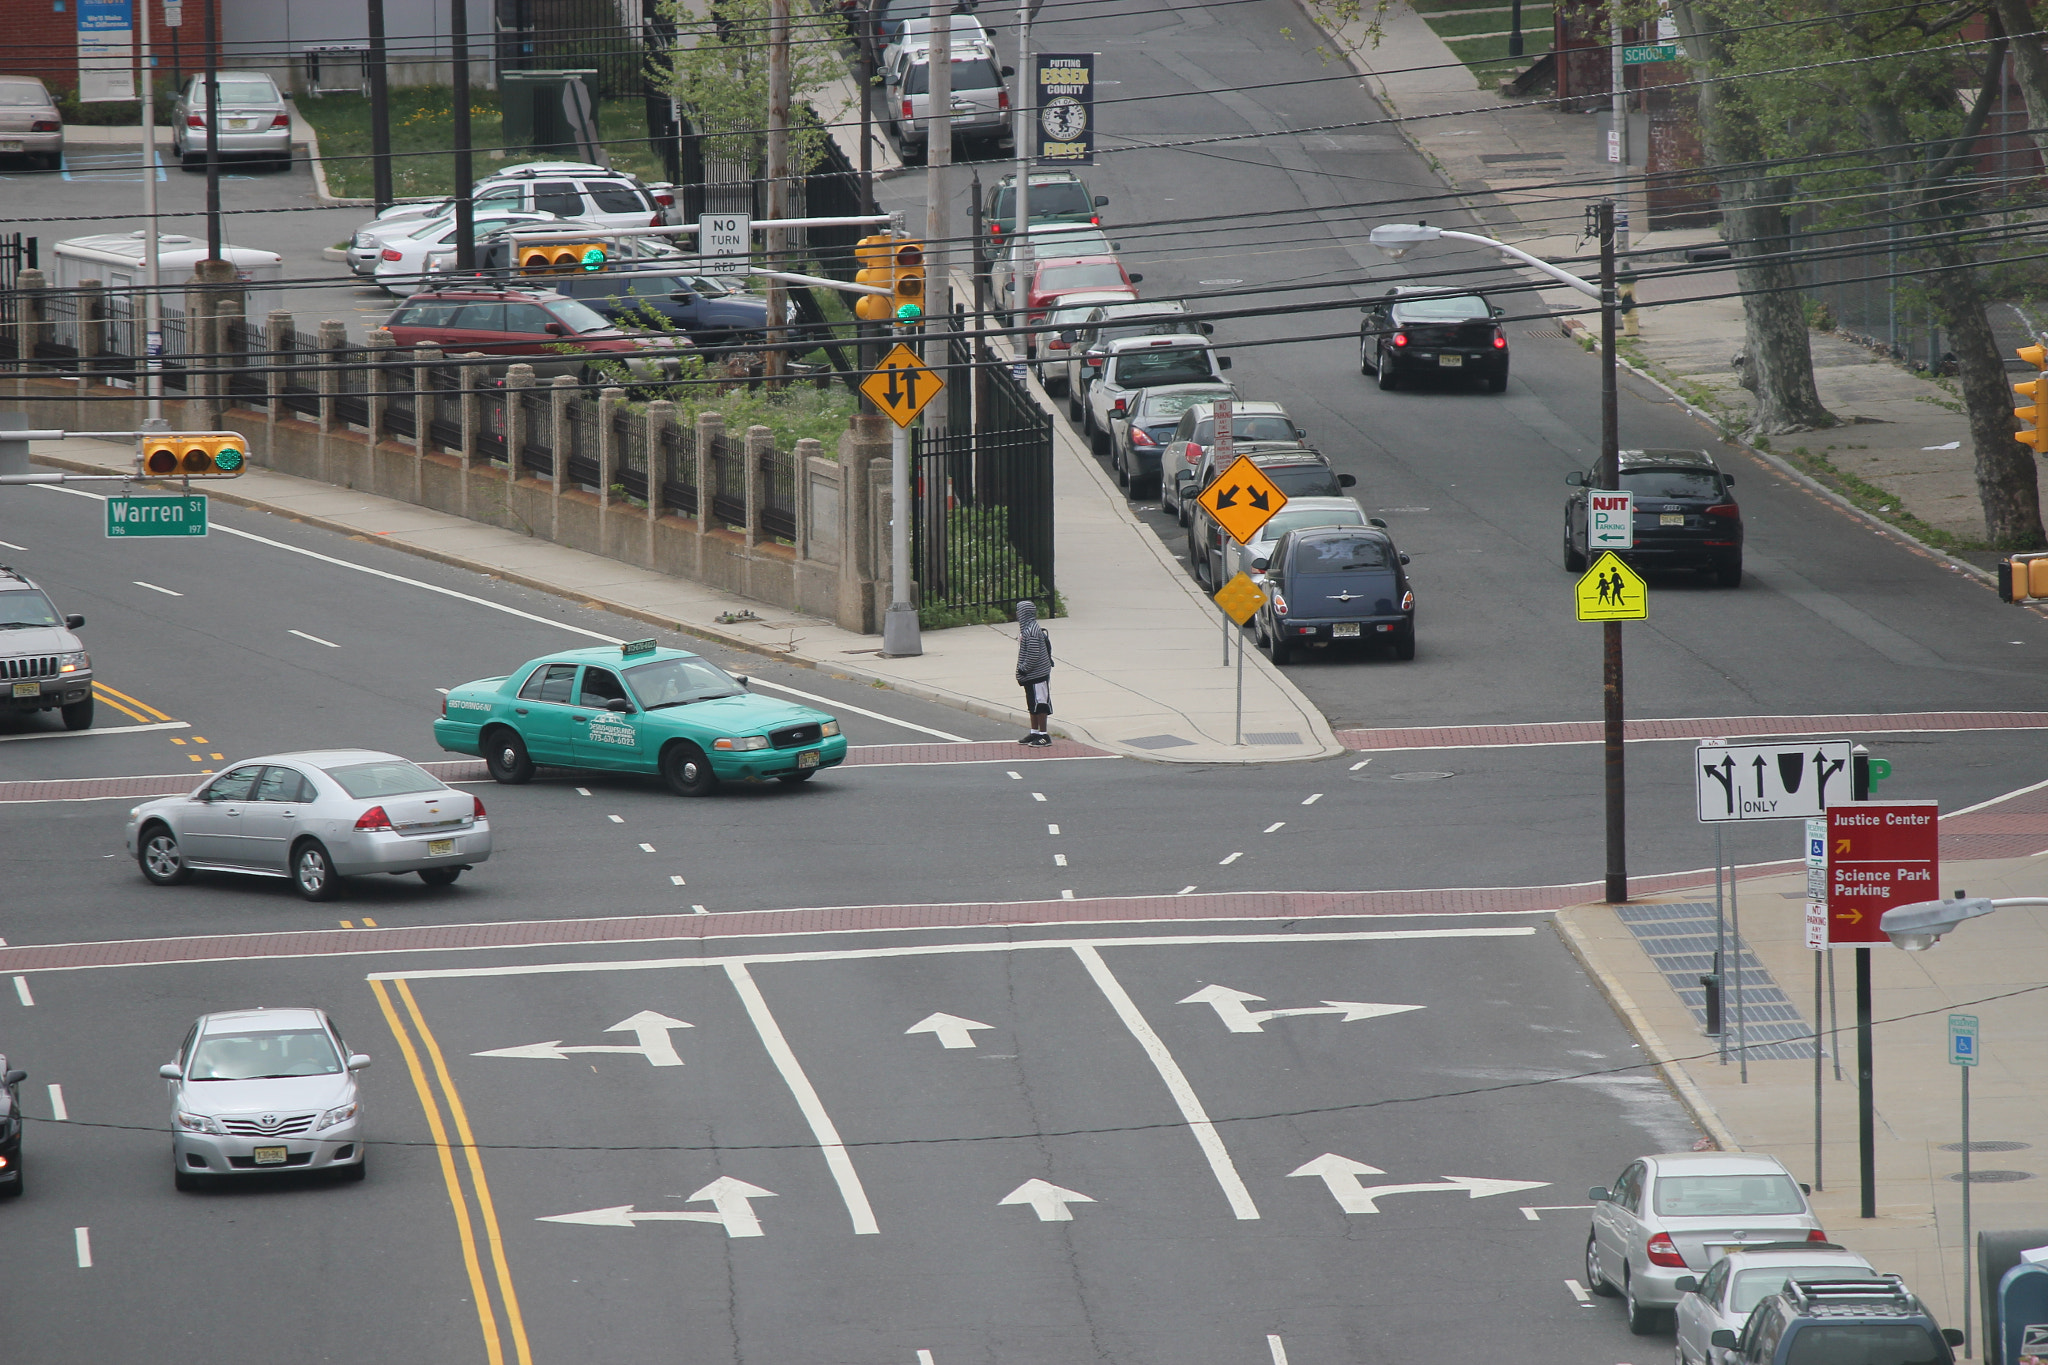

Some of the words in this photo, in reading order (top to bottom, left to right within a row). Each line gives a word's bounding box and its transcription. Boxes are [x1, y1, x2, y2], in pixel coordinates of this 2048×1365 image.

[1050, 59, 1081, 68] PUTTING
[1040, 67, 1089, 85] ESSEX
[1047, 85, 1085, 95] COUNTY
[1043, 142, 1087, 159] FIRST
[713, 219, 736, 231] NO
[711, 235, 740, 245] TURN
[717, 248, 733, 257] ON
[714, 261, 736, 272] RED
[1593, 497, 1628, 511] NJIT
[112, 501, 184, 523] Warren
[190, 501, 202, 512] St
[111, 526, 125, 535] 196
[189, 525, 202, 534] 197
[589, 733, 635, 747] 973-676-6023
[1869, 758, 1892, 793] P
[1743, 800, 1778, 813] ONLY
[1834, 813, 1880, 826] Justice
[1885, 812, 1931, 826] Center
[1835, 868, 1891, 881] Science
[1897, 868, 1931, 881] Park
[1834, 883, 1891, 898] Parking
[1812, 904, 1822, 915] NO
[1806, 914, 1827, 926] PARKING
[1811, 932, 1823, 940] TIME
